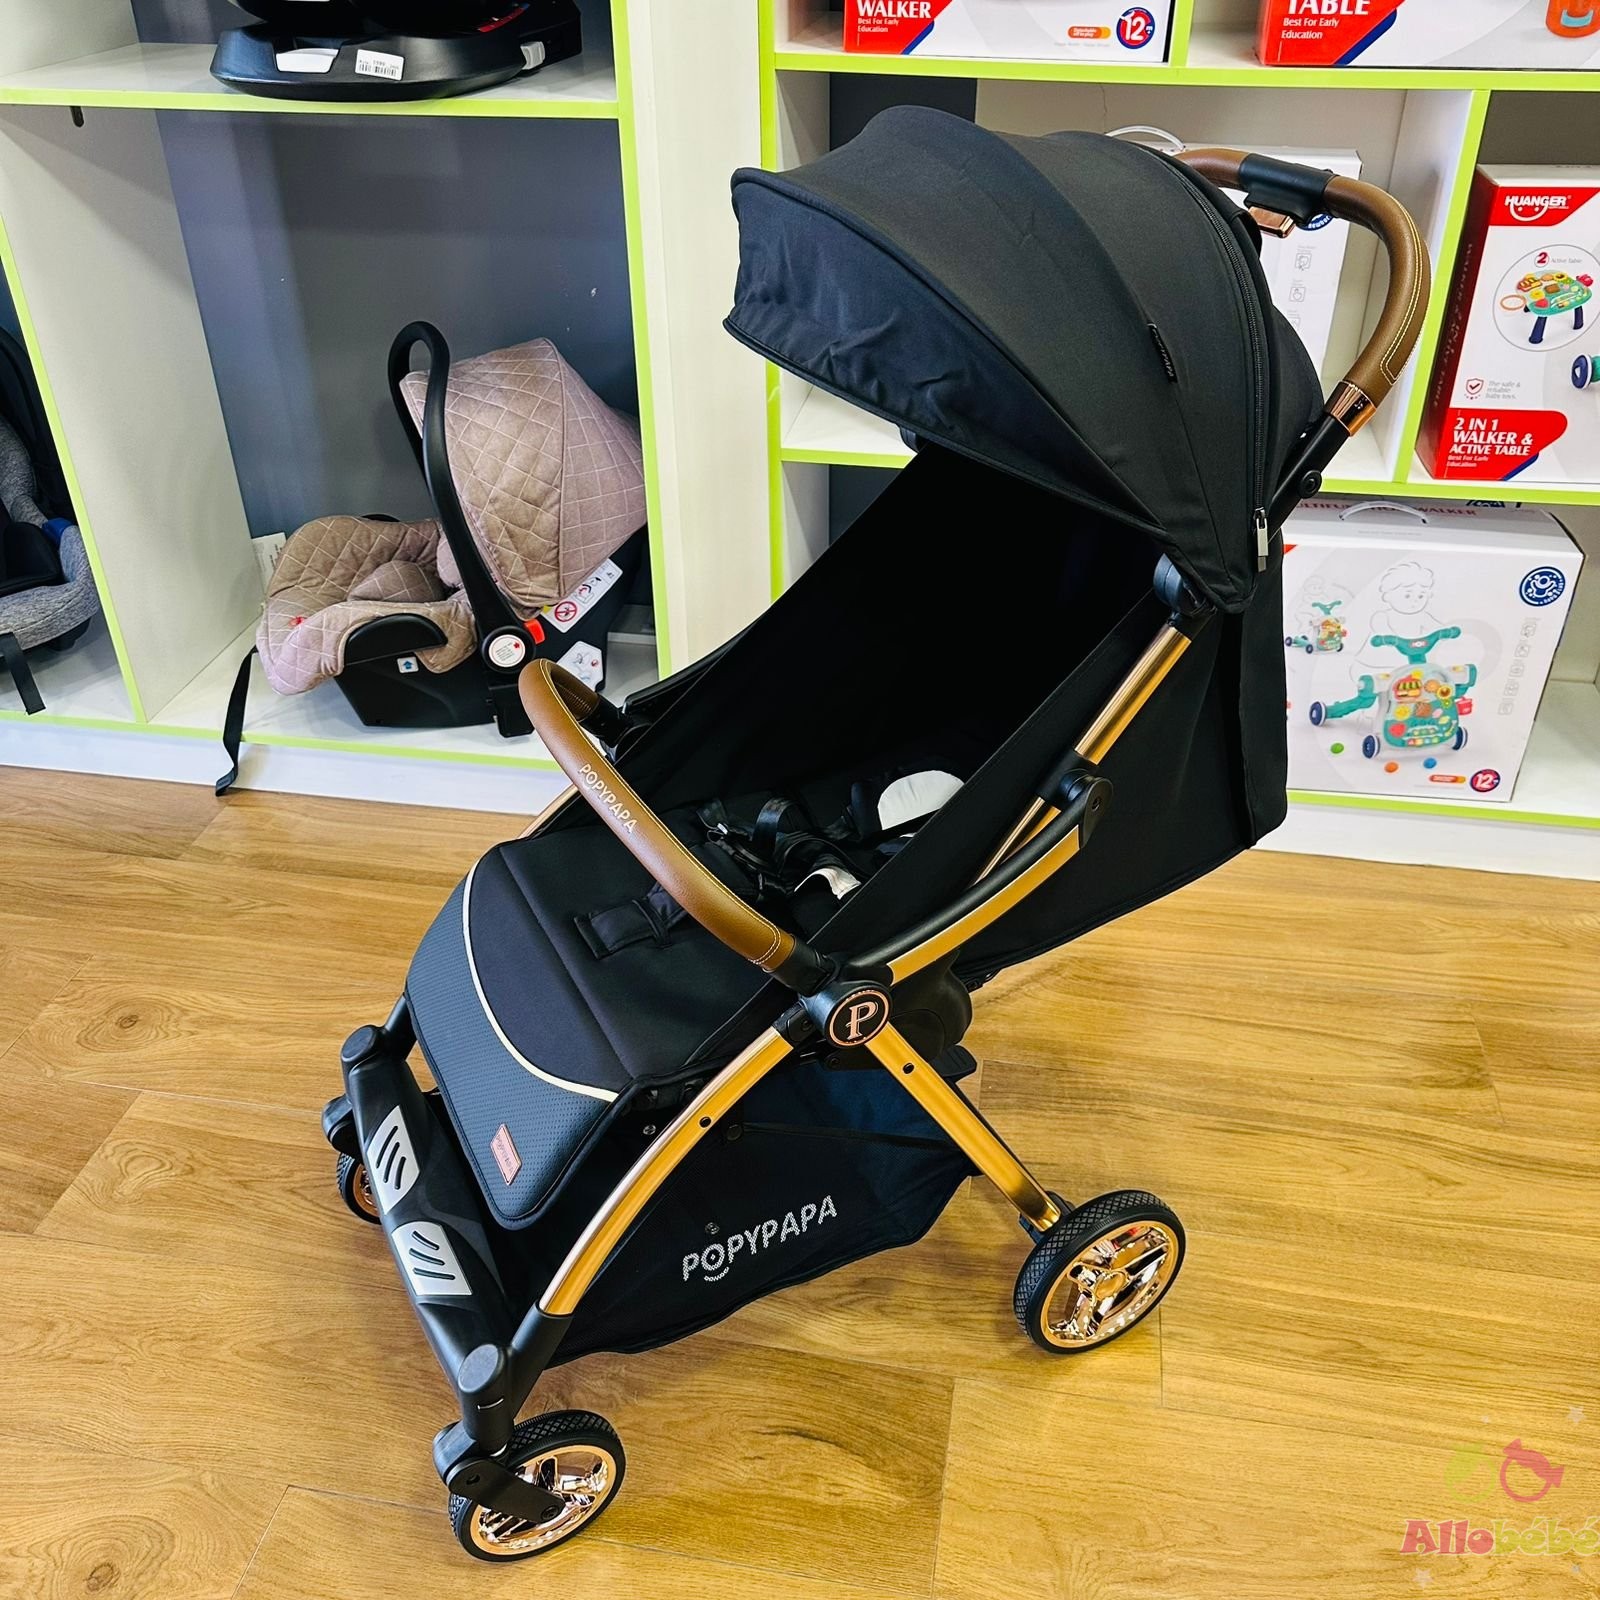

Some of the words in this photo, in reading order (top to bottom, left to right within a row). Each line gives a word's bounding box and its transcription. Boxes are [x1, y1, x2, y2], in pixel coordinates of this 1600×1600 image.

[857, 0, 932, 18] WALKER
[1288, 0, 1370, 15] TABLE
[884, 19, 899, 27] Early
[1283, 17, 1301, 27] Best
[1303, 18, 1317, 27] For
[1319, 18, 1339, 28] Early
[1281, 30, 1323, 39] Education
[1537, 252, 1548, 264] 2
[1454, 418, 1465, 429] 2
[1468, 418, 1487, 431] IN
[1491, 419, 1499, 431] 1
[1454, 431, 1517, 445] WALKER
[1521, 433, 1533, 445] &
[1449, 444, 1492, 454] ACTIVE
[1494, 445, 1530, 456] TABLE
[1475, 773, 1494, 790] 12
[579, 763, 638, 833] POPYPAPA
[845, 1001, 879, 1040] P
[683, 1195, 838, 1282] POPYPAPA
